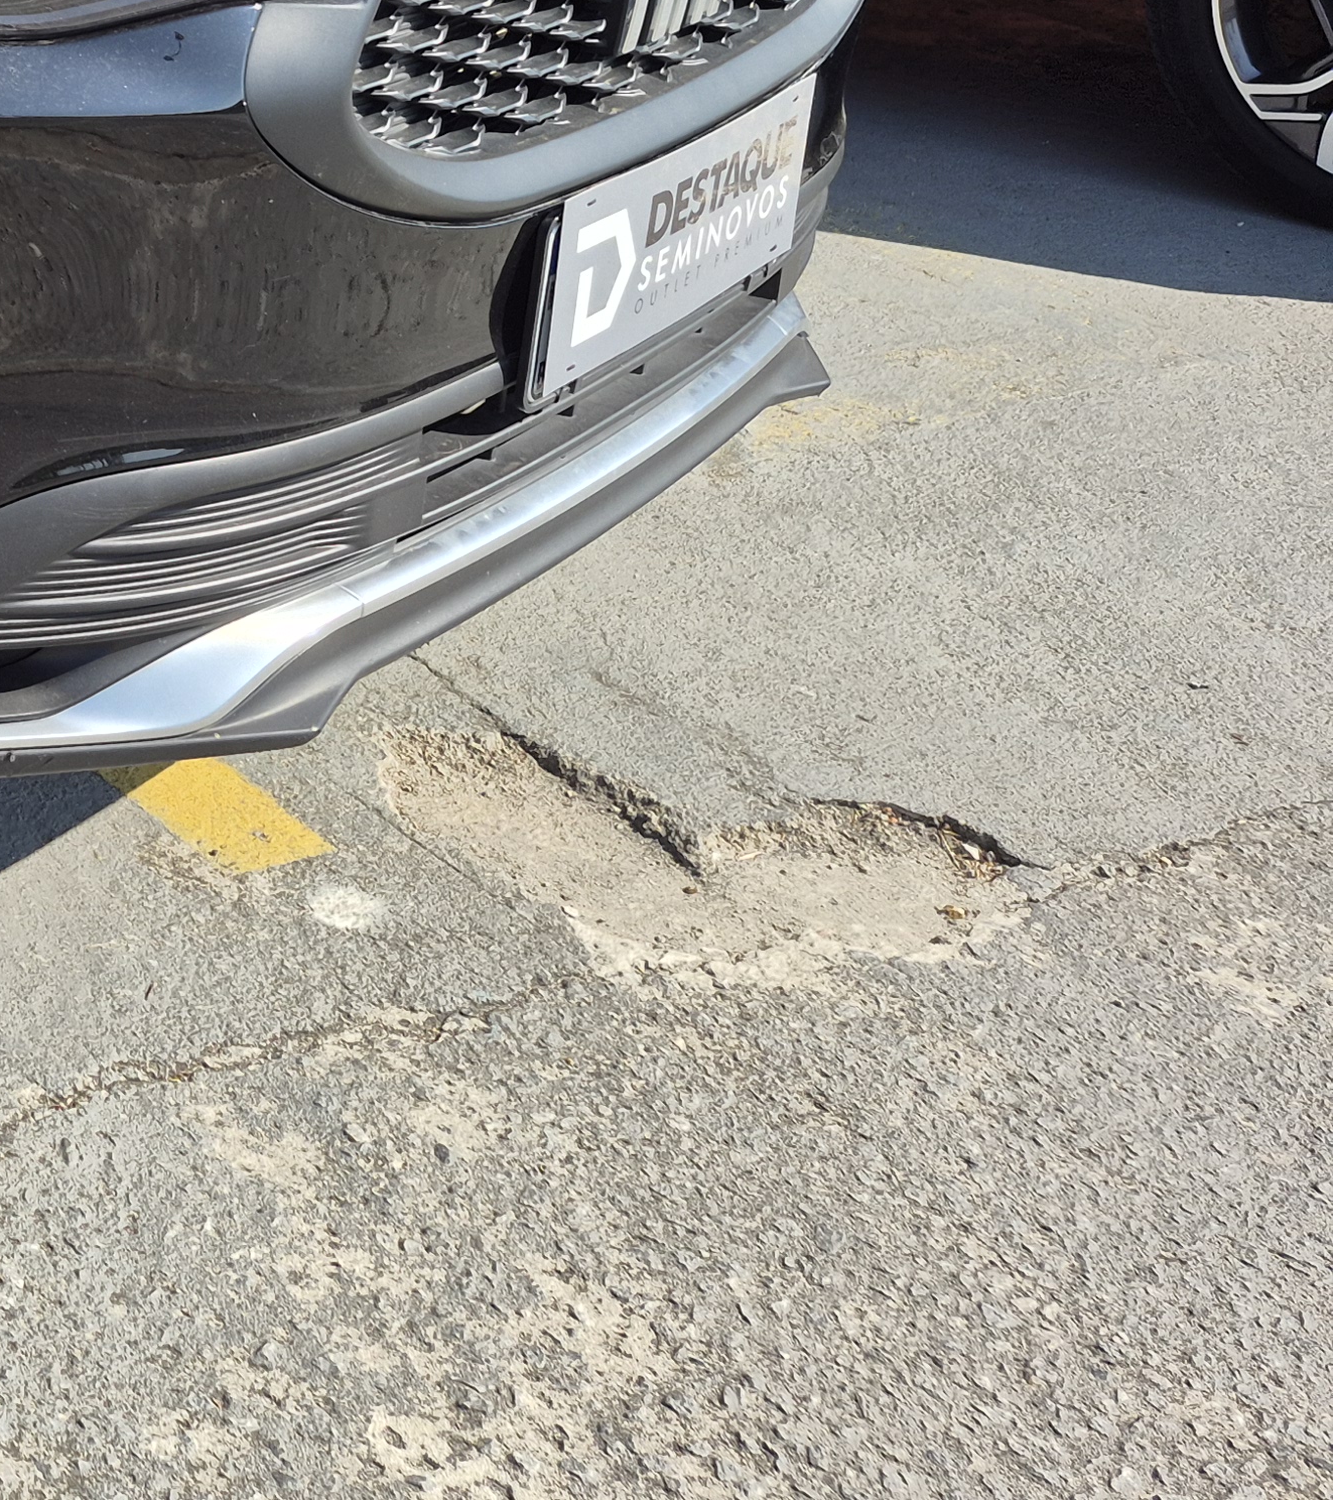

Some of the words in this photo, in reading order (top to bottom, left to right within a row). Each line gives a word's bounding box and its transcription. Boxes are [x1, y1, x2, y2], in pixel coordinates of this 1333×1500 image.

[637, 174, 789, 292] SEMINOVOS
[644, 115, 799, 249] DESTAQUE
[634, 264, 702, 315] OUTLET
[713, 215, 784, 269] PREMIUM
